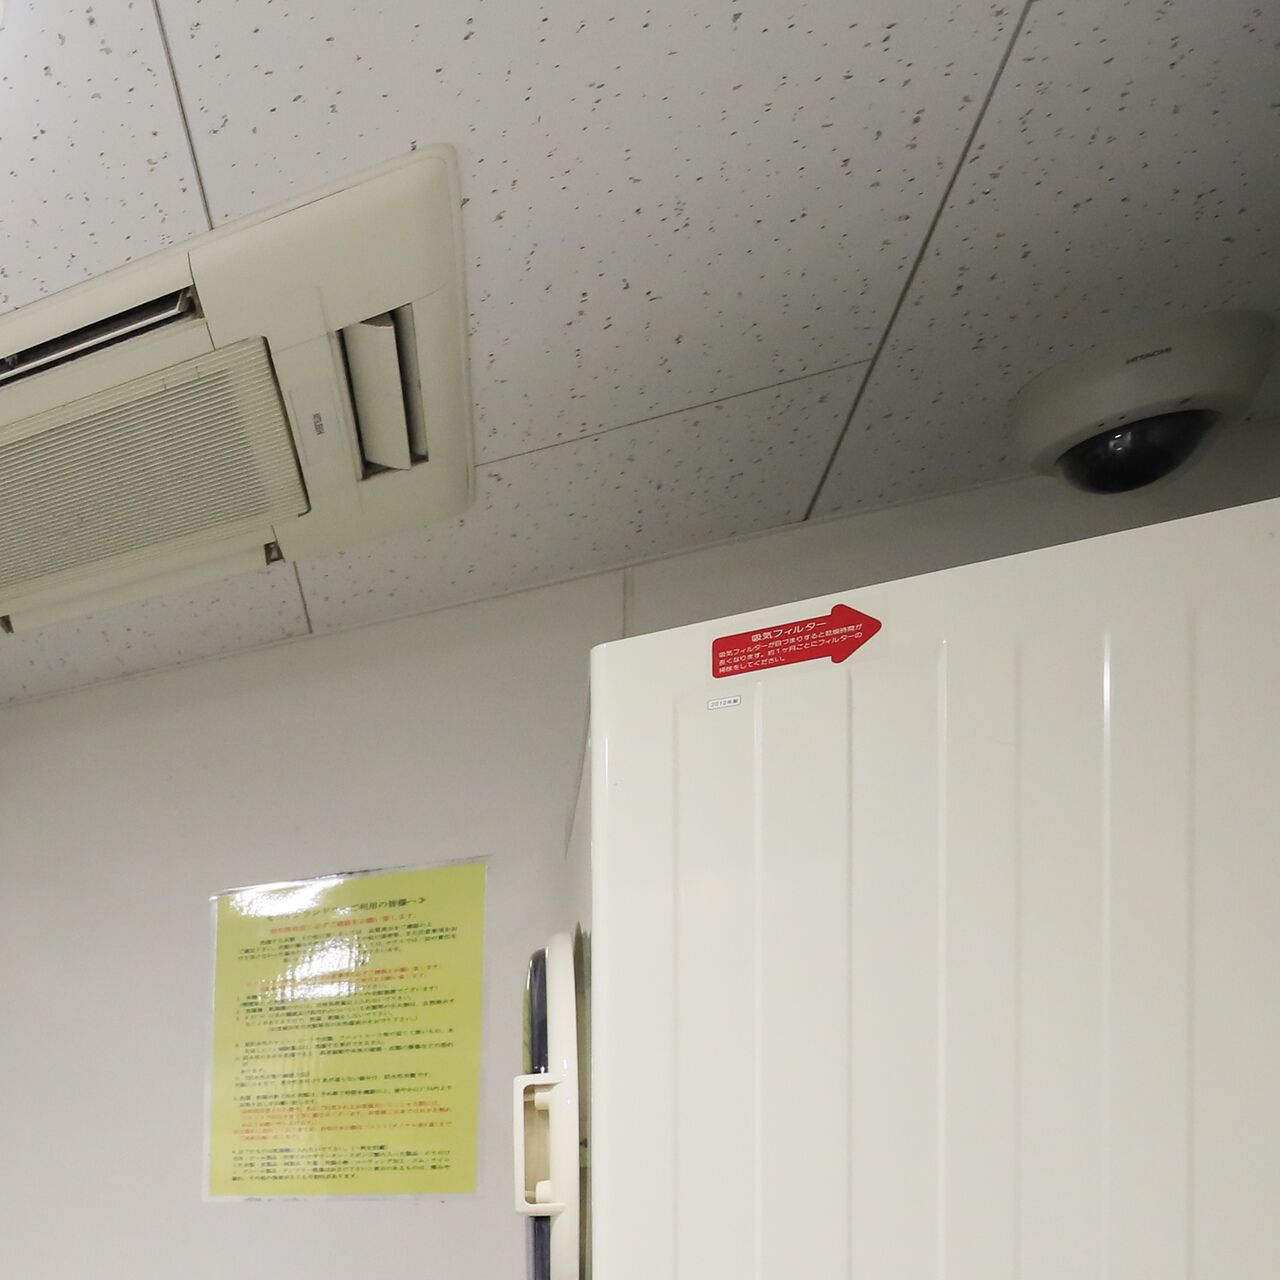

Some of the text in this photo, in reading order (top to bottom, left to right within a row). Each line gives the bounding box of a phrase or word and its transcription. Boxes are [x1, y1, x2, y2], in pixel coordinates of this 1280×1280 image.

[719, 624, 863, 658] 吸気フィルターが目づまりすると乾燥時間が
[752, 622, 827, 642] 吸気フィルター
[719, 632, 863, 666] 長くなります。約1ヶ月ごとにフィルターの
[719, 657, 785, 673] 掃除をしてください。
